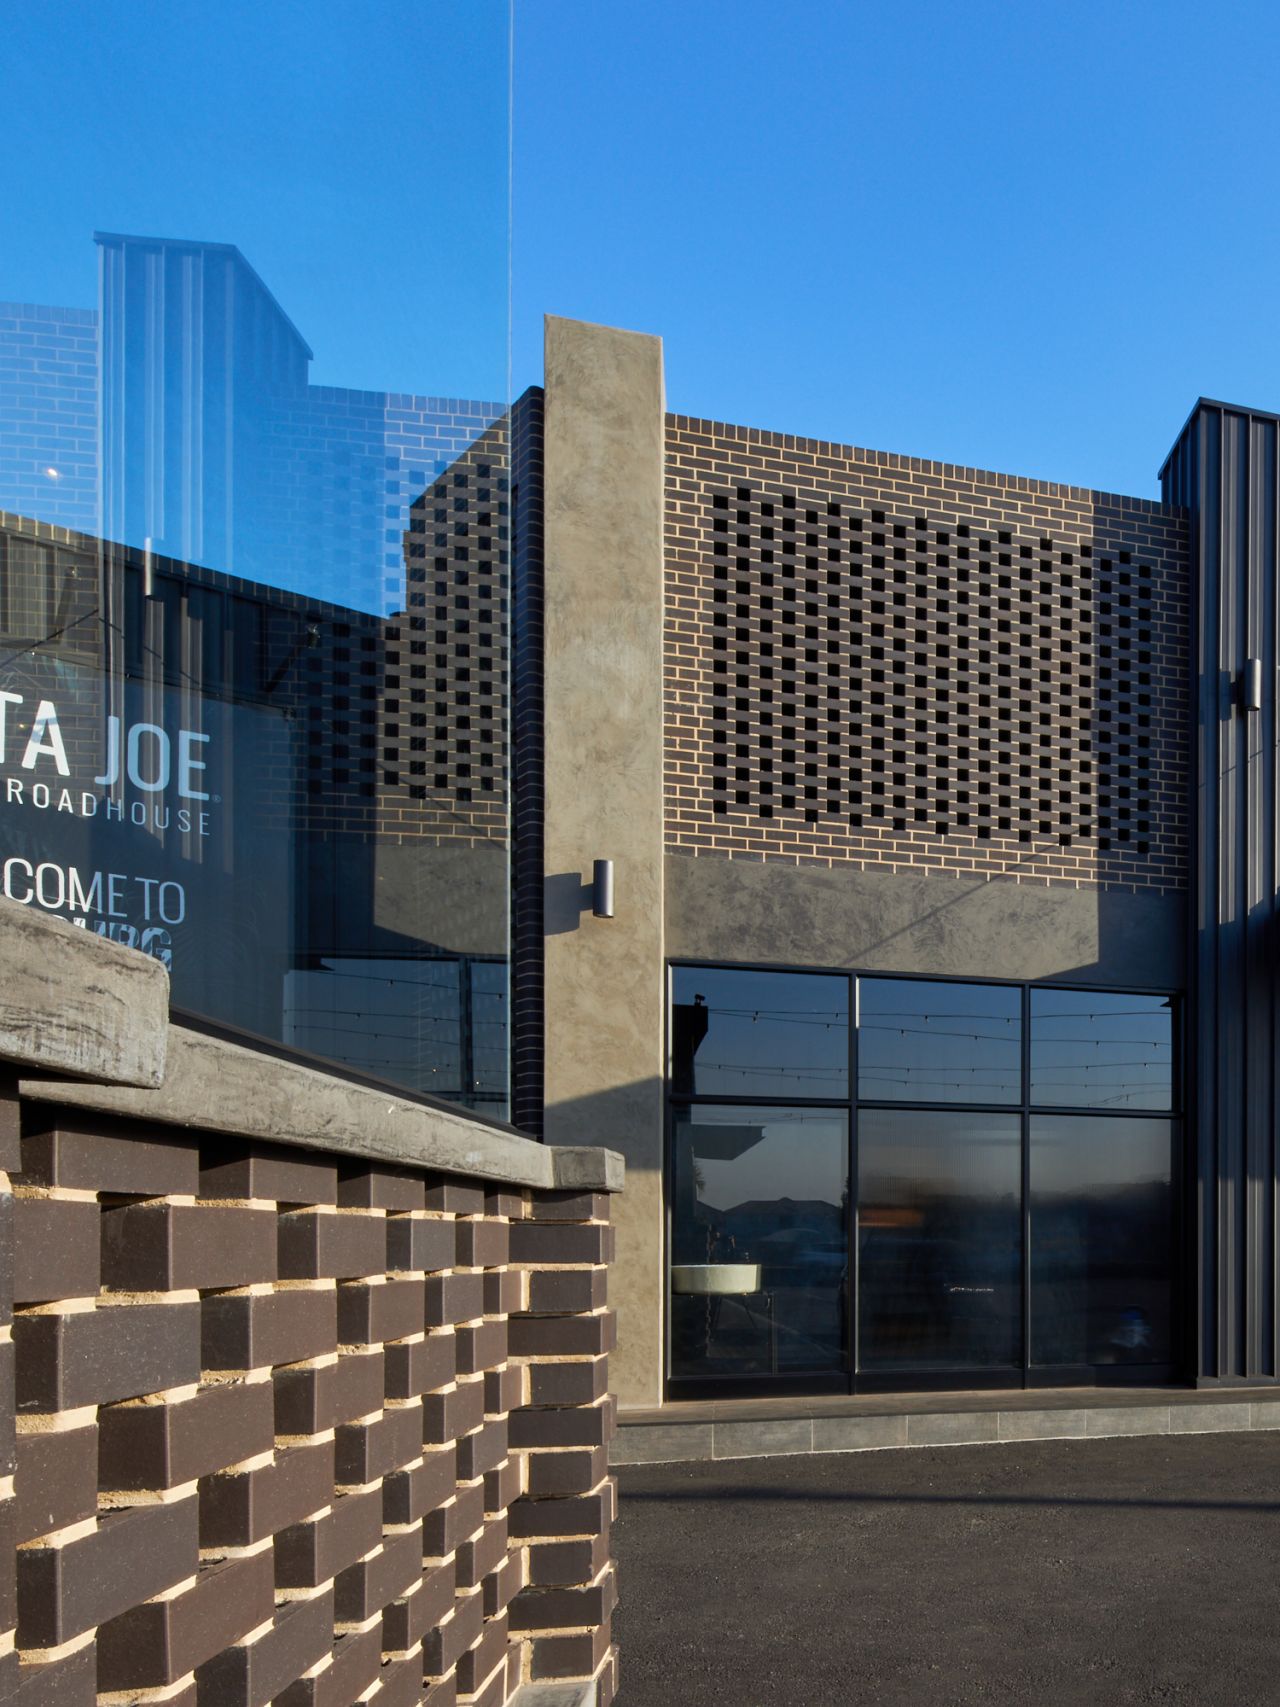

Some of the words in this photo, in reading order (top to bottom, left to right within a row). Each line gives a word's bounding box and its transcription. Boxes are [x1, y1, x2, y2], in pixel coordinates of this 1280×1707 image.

[95, 715, 210, 801] JOE
[7, 778, 211, 836] ROADHOUSE
[135, 877, 186, 925] TO
